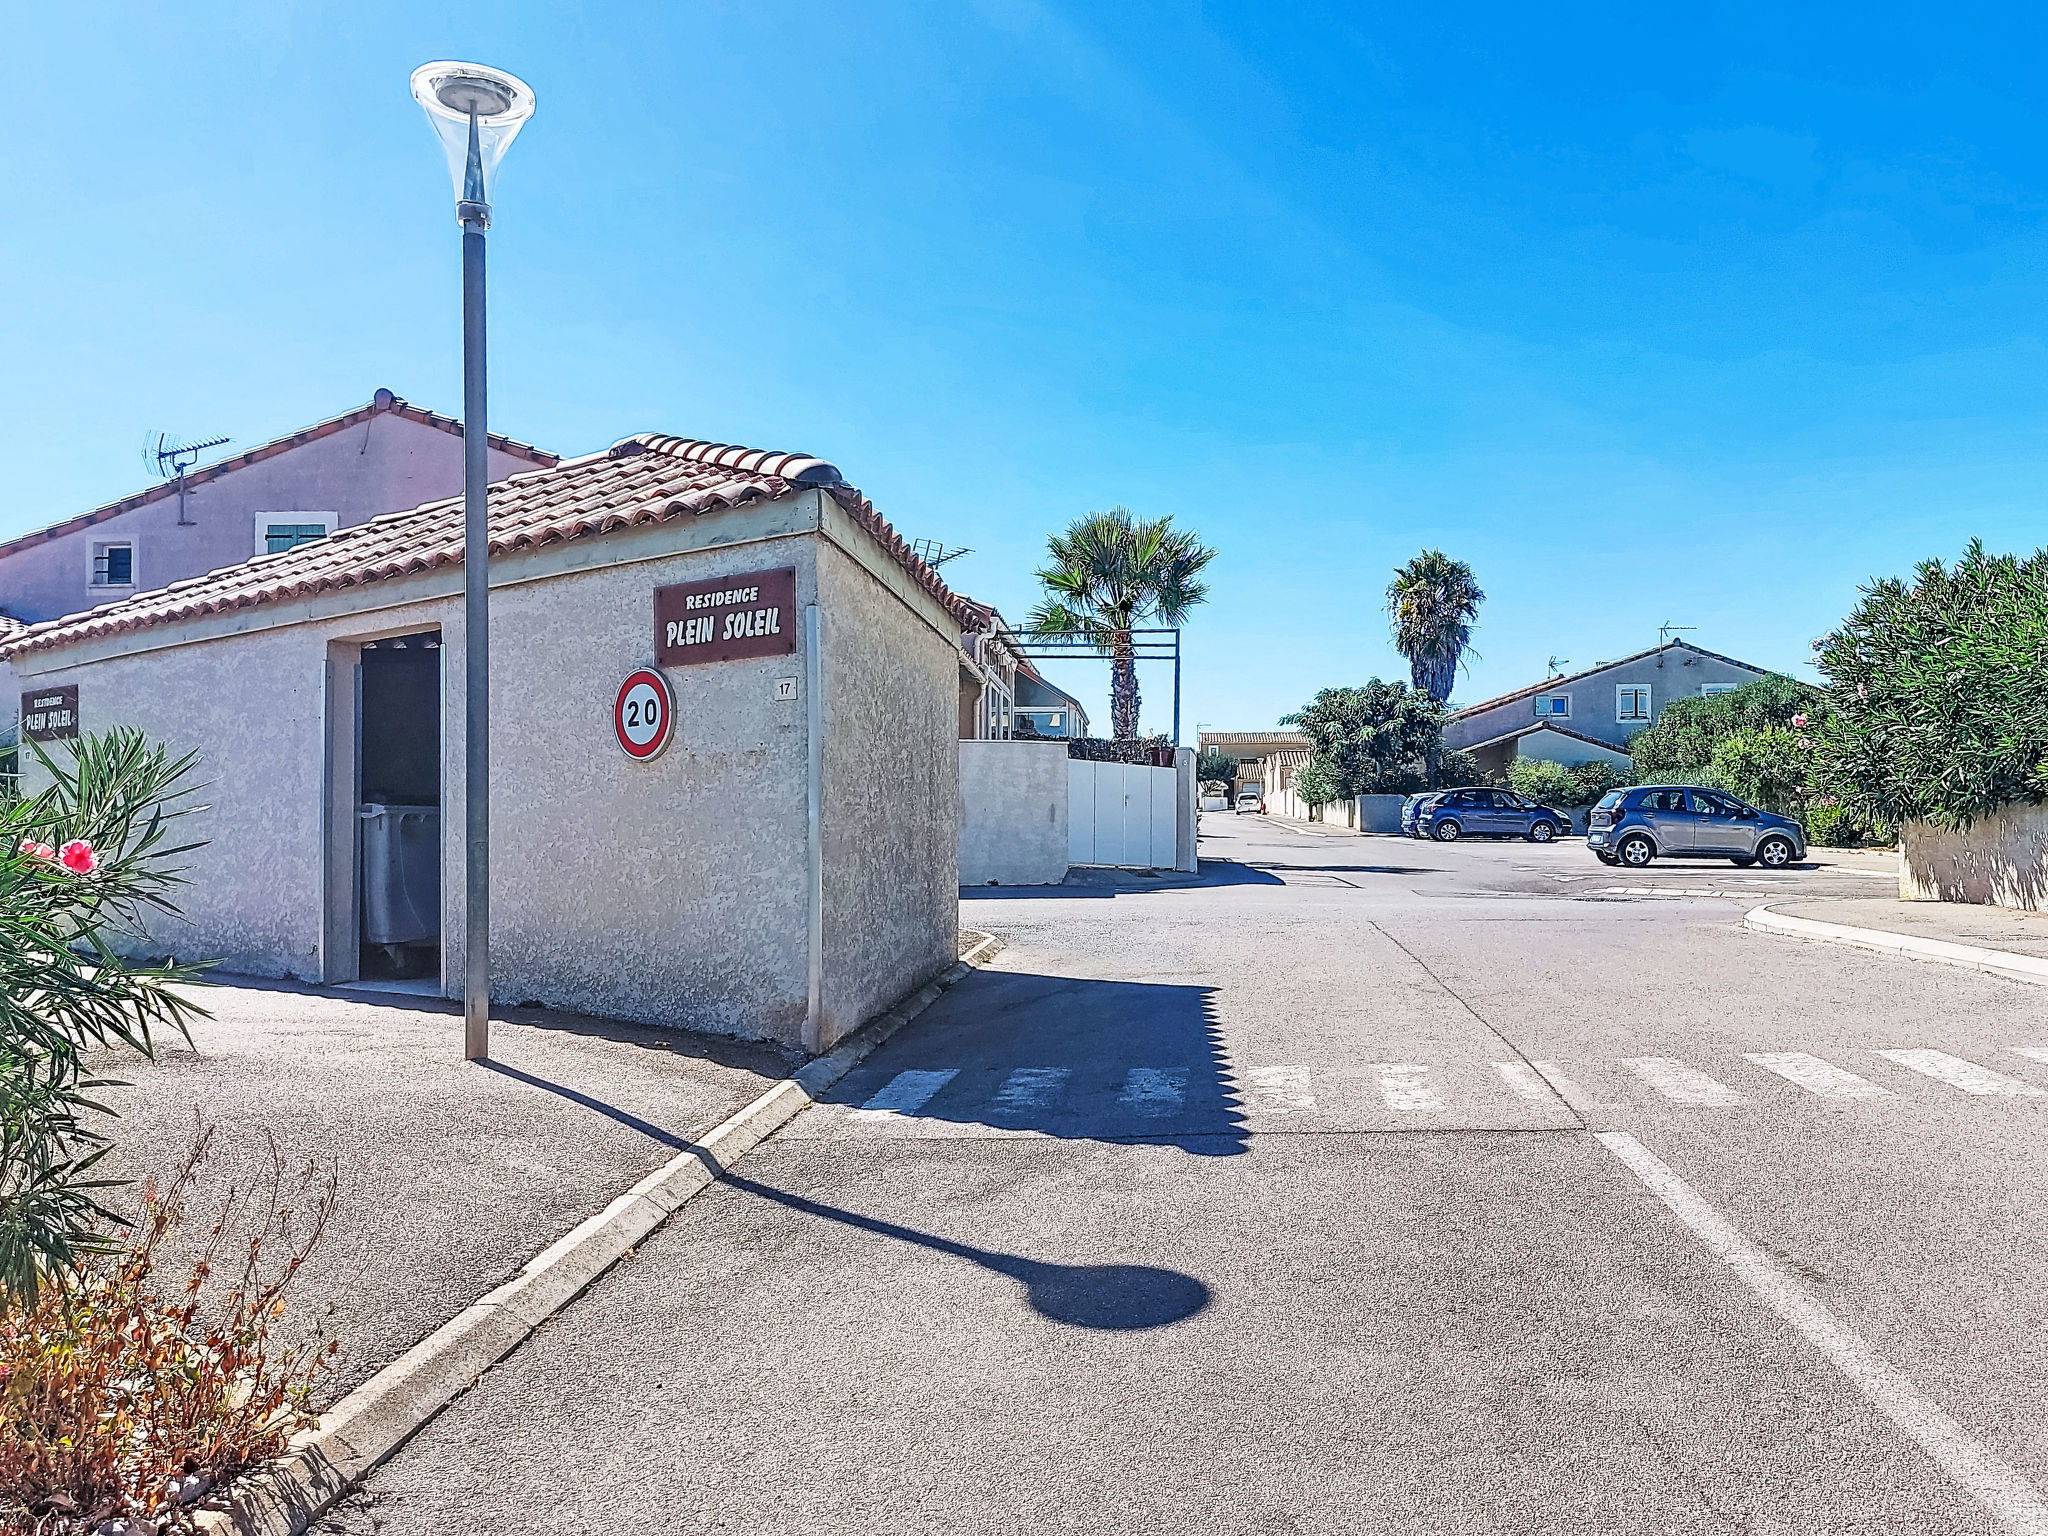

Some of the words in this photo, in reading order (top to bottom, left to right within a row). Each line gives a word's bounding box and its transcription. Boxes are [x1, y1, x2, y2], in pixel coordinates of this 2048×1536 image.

[686, 587, 758, 609] RESIDENCE
[666, 615, 715, 648] PLEIN
[722, 607, 781, 640] SOLEIL
[779, 683, 791, 695] 17
[26, 713, 46, 731] PLEIN
[48, 710, 71, 728] SOLEIL
[627, 698, 657, 728] 20
